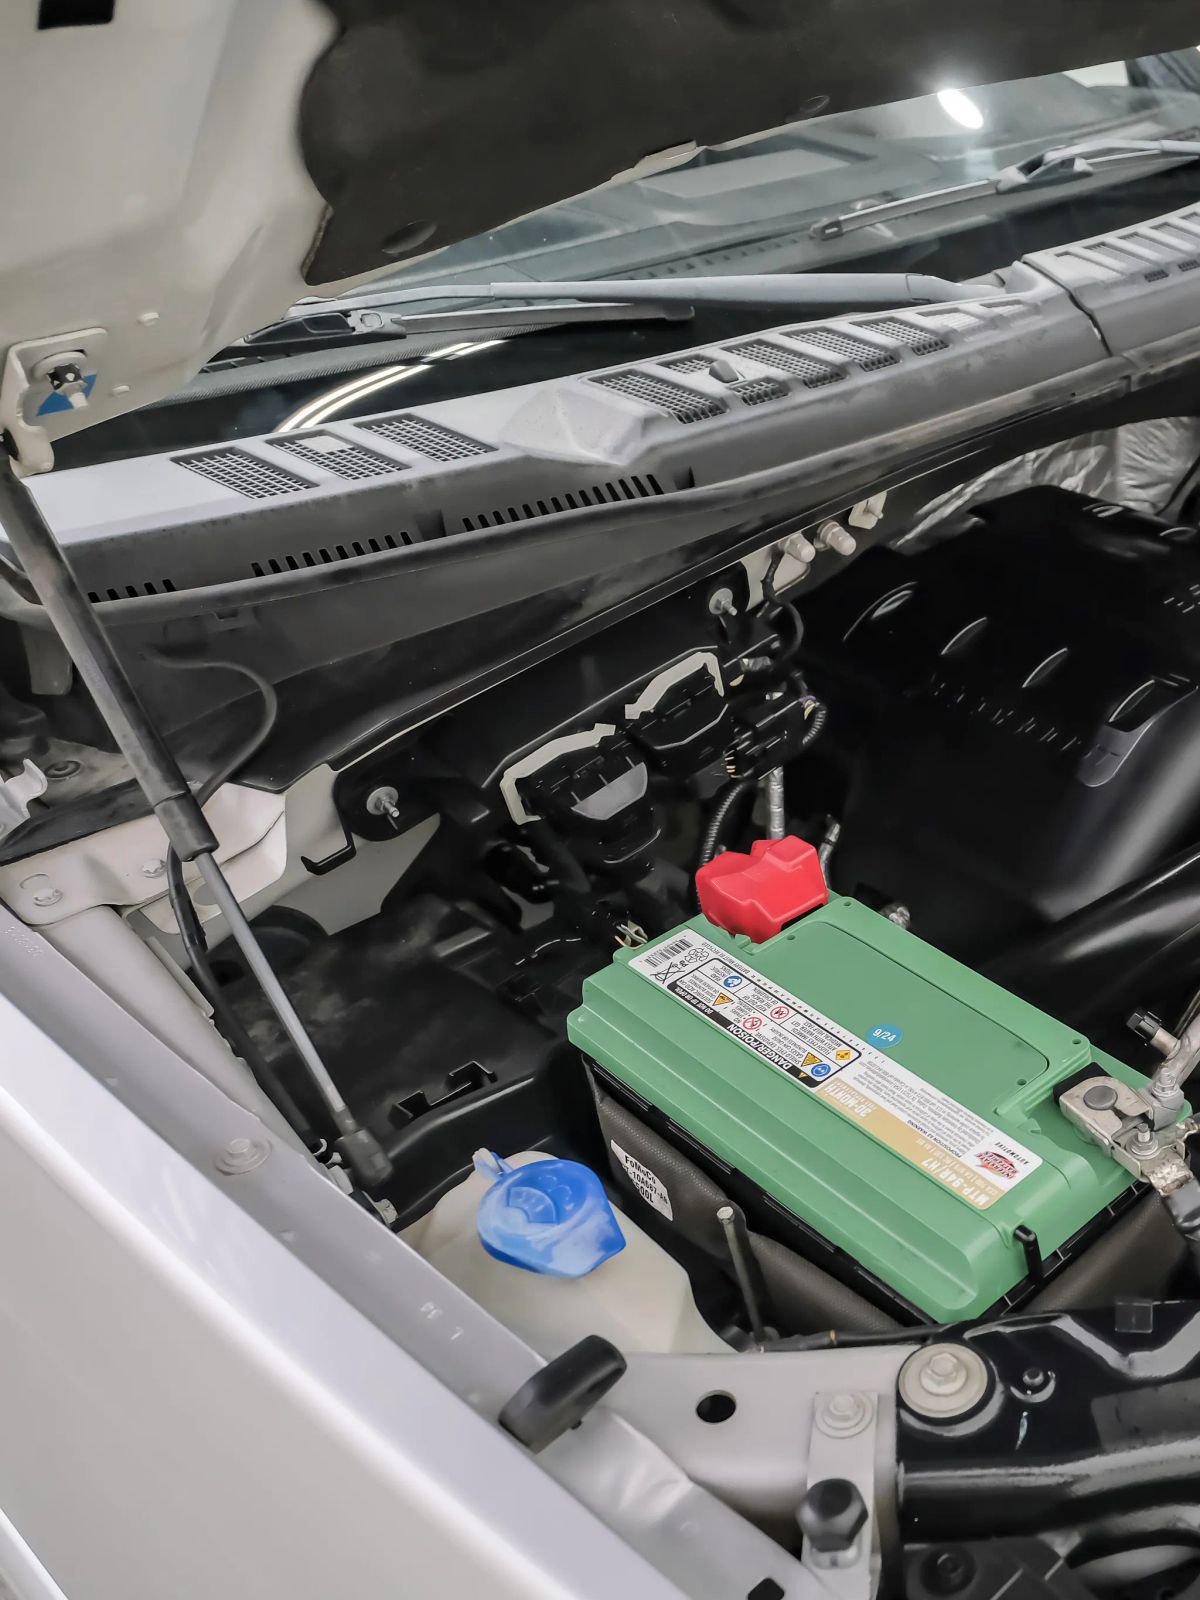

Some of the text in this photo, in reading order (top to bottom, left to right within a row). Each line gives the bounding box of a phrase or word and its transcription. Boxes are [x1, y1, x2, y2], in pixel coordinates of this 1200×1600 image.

[677, 959, 688, 967] Pb
[750, 993, 765, 1003] REACH
[695, 1001, 707, 1010] NOT
[755, 1003, 767, 1011] KEEP
[790, 1019, 801, 1027] GET
[812, 1027, 825, 1035] HELP
[873, 1028, 897, 1042] 9/24
[806, 1037, 818, 1046] EYES
[812, 1034, 826, 1043] WITH
[725, 1023, 793, 1069] DANGER/POISON
[816, 1044, 831, 1054] FLUSH
[788, 1048, 804, 1058] GASES
[784, 1053, 801, 1064] SHIELD
[993, 1141, 1029, 1165] AUTOMOTIVE
[975, 1152, 1014, 1179] INTERSTATE
[982, 1150, 1017, 1174] BATTERIES
[624, 1155, 656, 1184] FoMoCo
